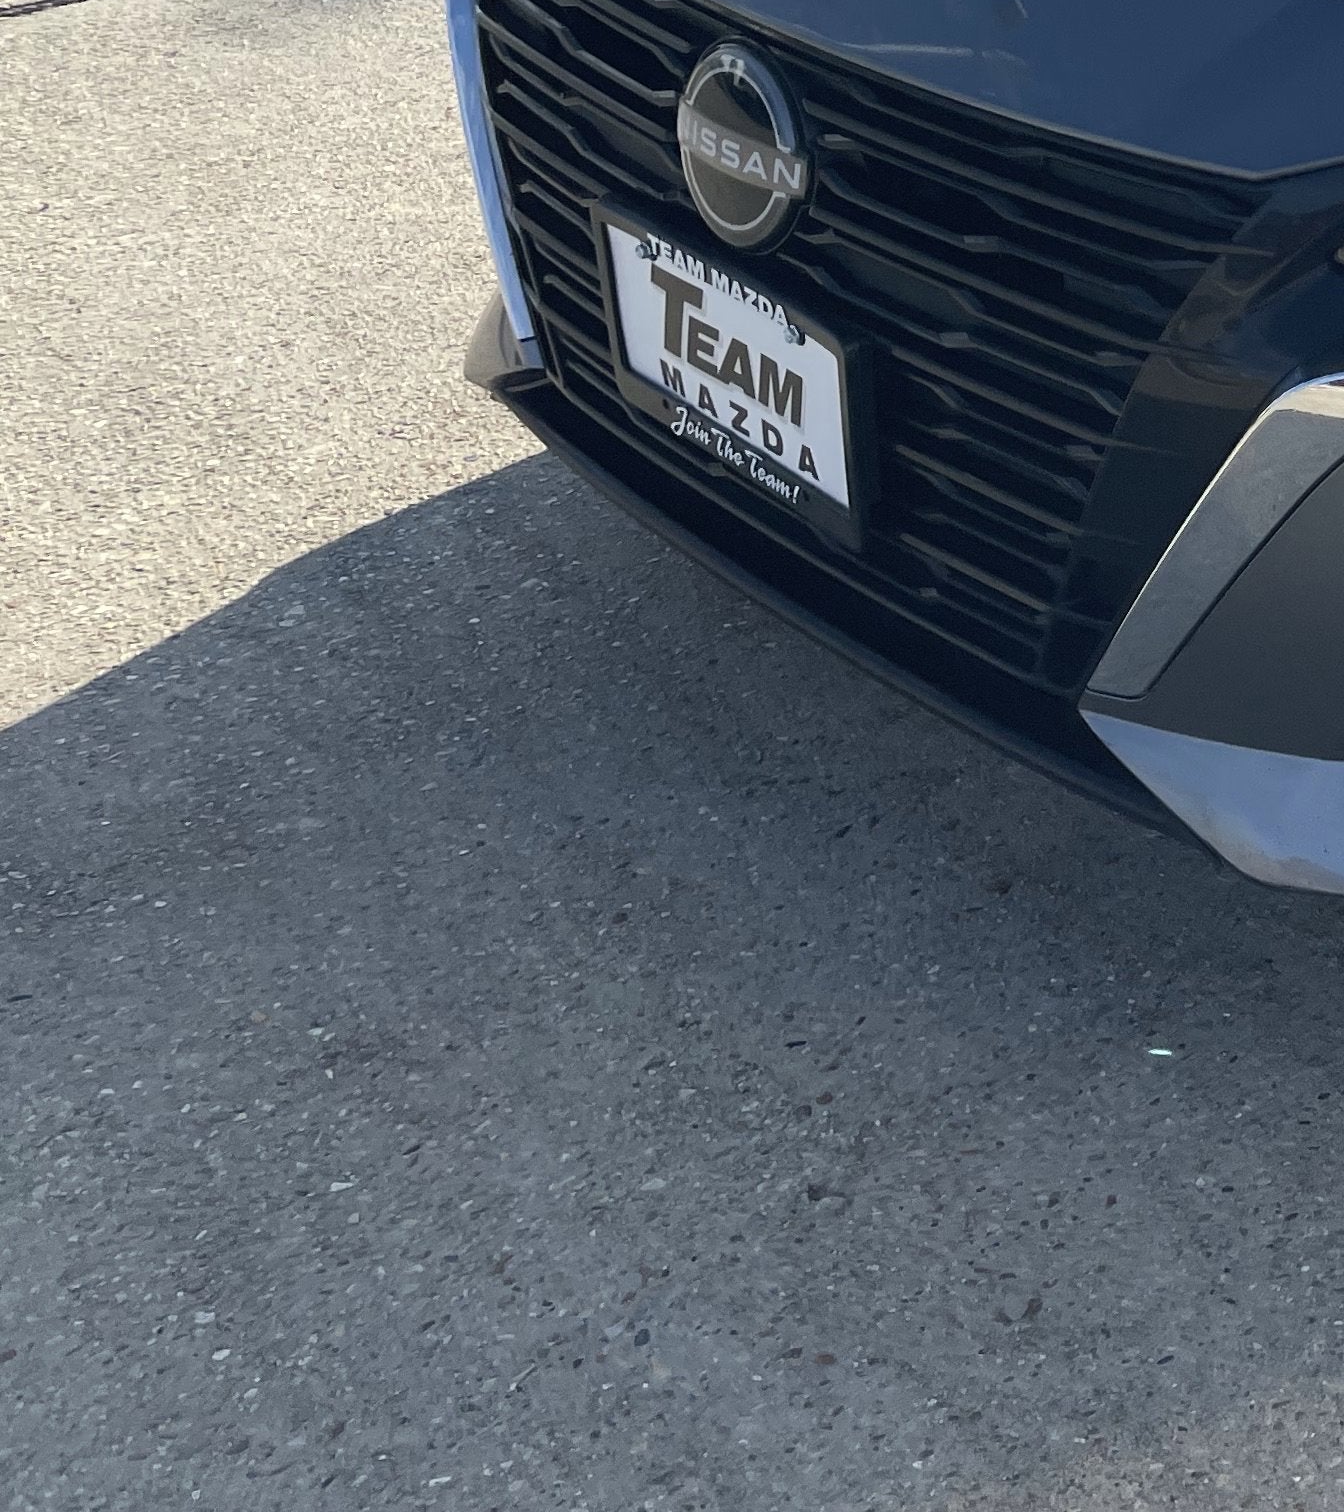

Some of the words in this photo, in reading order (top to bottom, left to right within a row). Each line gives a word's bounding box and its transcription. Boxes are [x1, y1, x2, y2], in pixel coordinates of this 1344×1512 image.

[681, 110, 801, 189] NISSAN
[647, 232, 706, 282] TEAM
[711, 268, 789, 329] MAZDA
[651, 263, 803, 428] TEAM
[660, 359, 820, 482] MAZDA
[671, 406, 712, 445] Join
[711, 427, 745, 467] The
[744, 449, 800, 504] Team!
